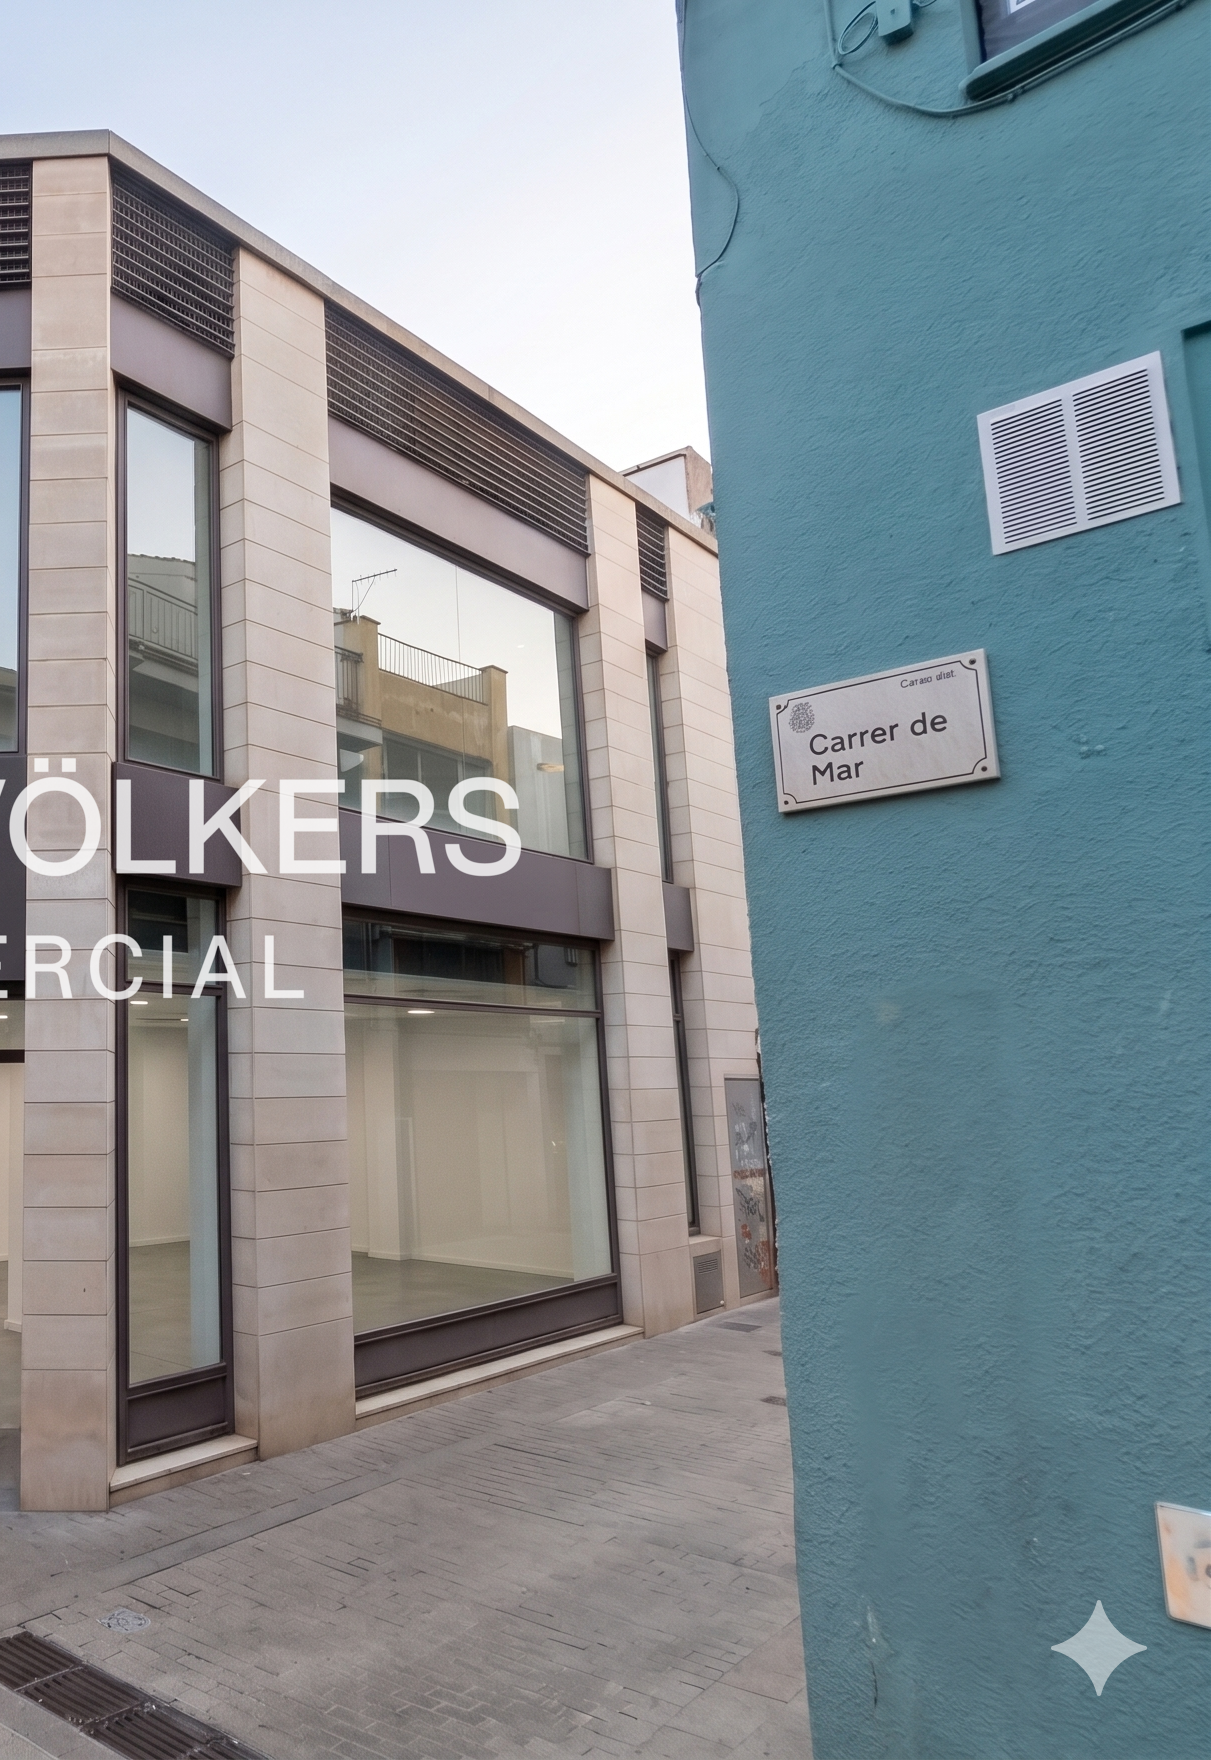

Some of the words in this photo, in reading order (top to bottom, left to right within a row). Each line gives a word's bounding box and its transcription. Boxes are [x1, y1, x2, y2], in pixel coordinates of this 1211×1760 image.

[809, 722, 899, 756] Carrer
[910, 711, 948, 737] de
[811, 760, 865, 786] Mar
